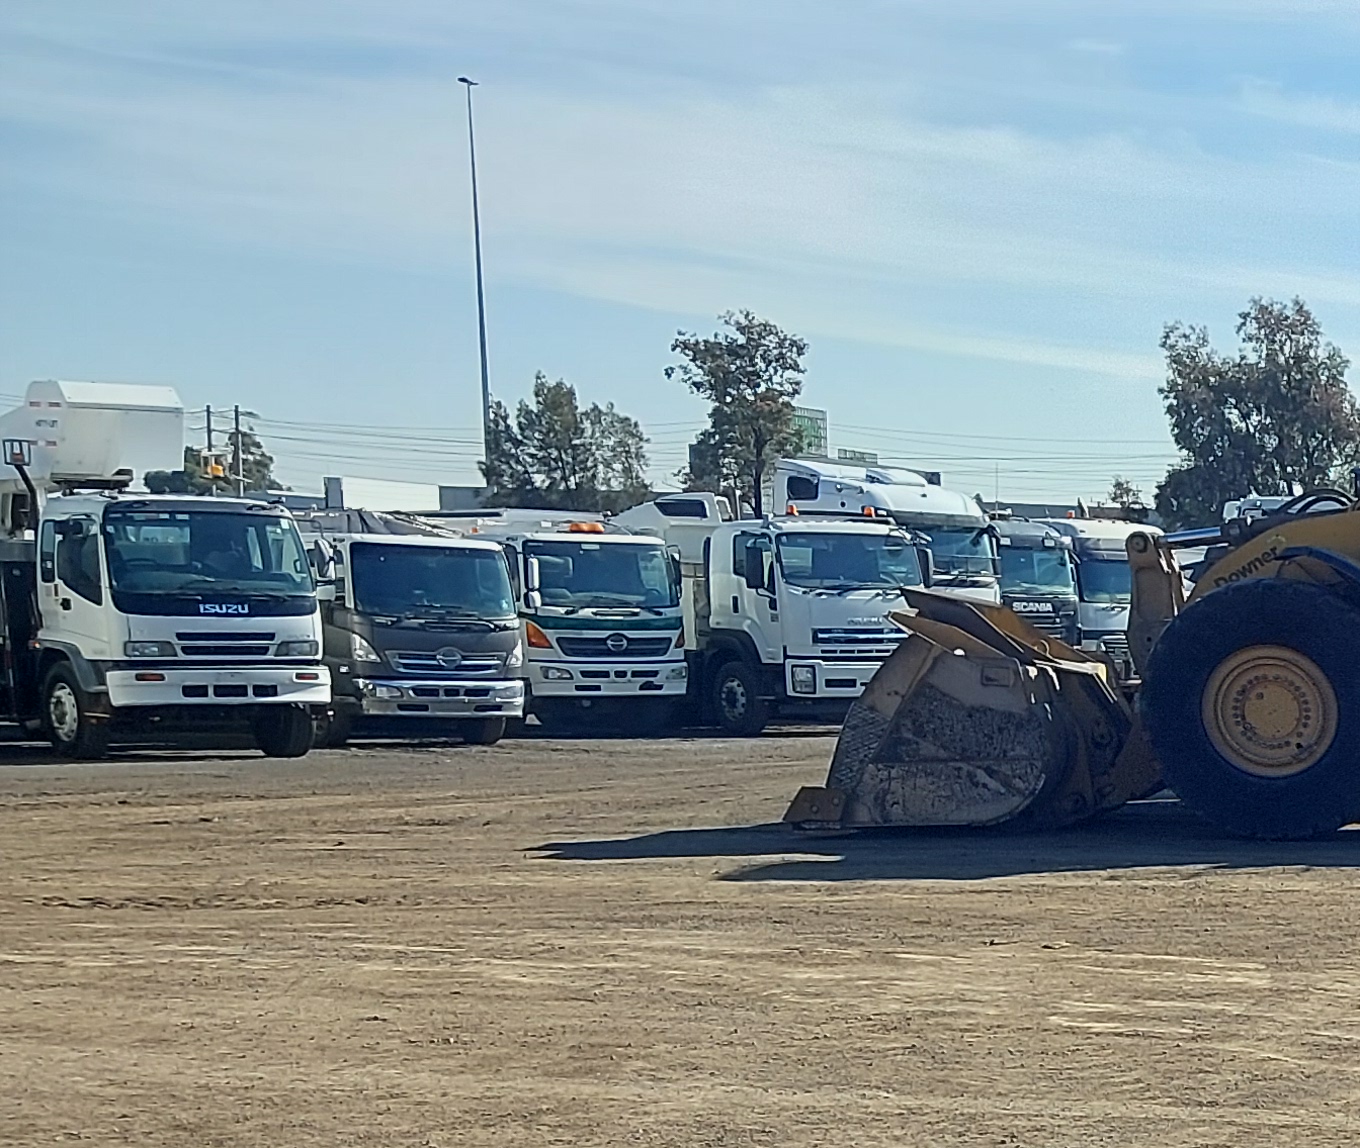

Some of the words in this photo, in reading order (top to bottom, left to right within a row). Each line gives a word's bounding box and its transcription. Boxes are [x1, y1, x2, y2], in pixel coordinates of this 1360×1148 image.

[1213, 545, 1278, 588] Downer
[198, 603, 250, 614] ISUZU
[1012, 601, 1054, 612] SCANIA
